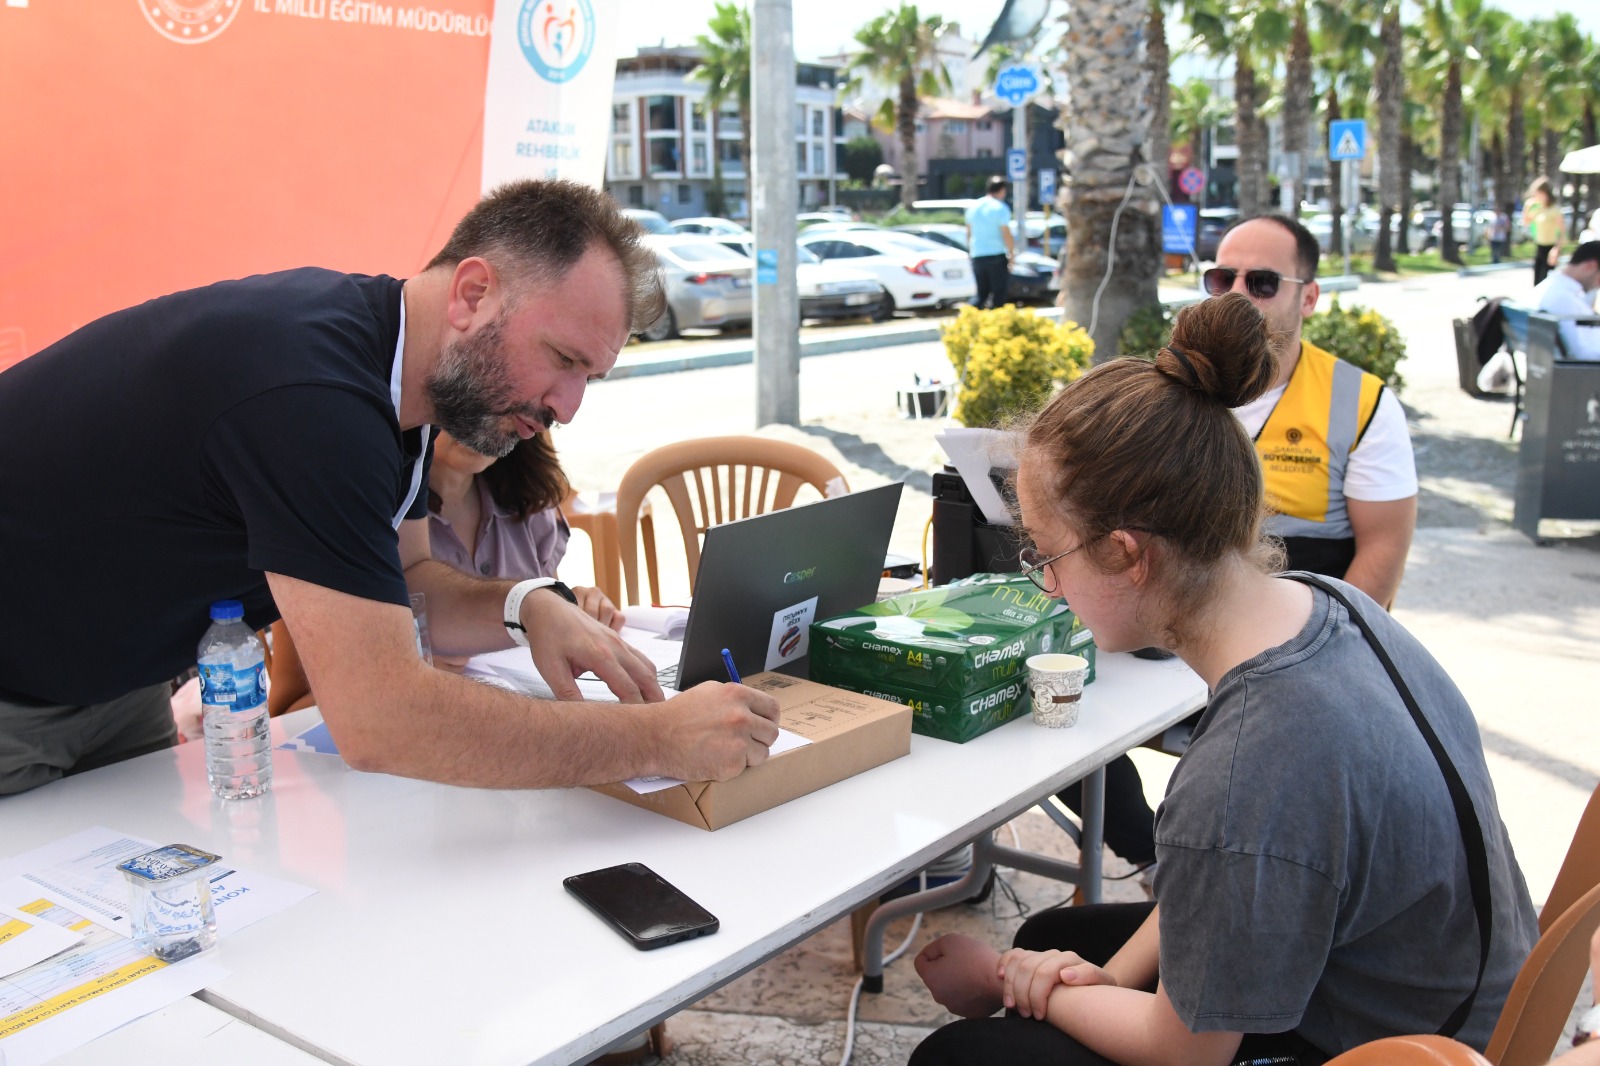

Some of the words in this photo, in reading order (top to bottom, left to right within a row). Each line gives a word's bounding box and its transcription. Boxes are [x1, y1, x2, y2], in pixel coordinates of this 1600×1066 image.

[396, 7, 494, 37] MÜDÜRLÜ
[992, 585, 1051, 612] multi
[1003, 608, 1017, 618] dia
[1024, 614, 1038, 624] dia
[907, 650, 923, 663] A4
[908, 699, 923, 712] A4
